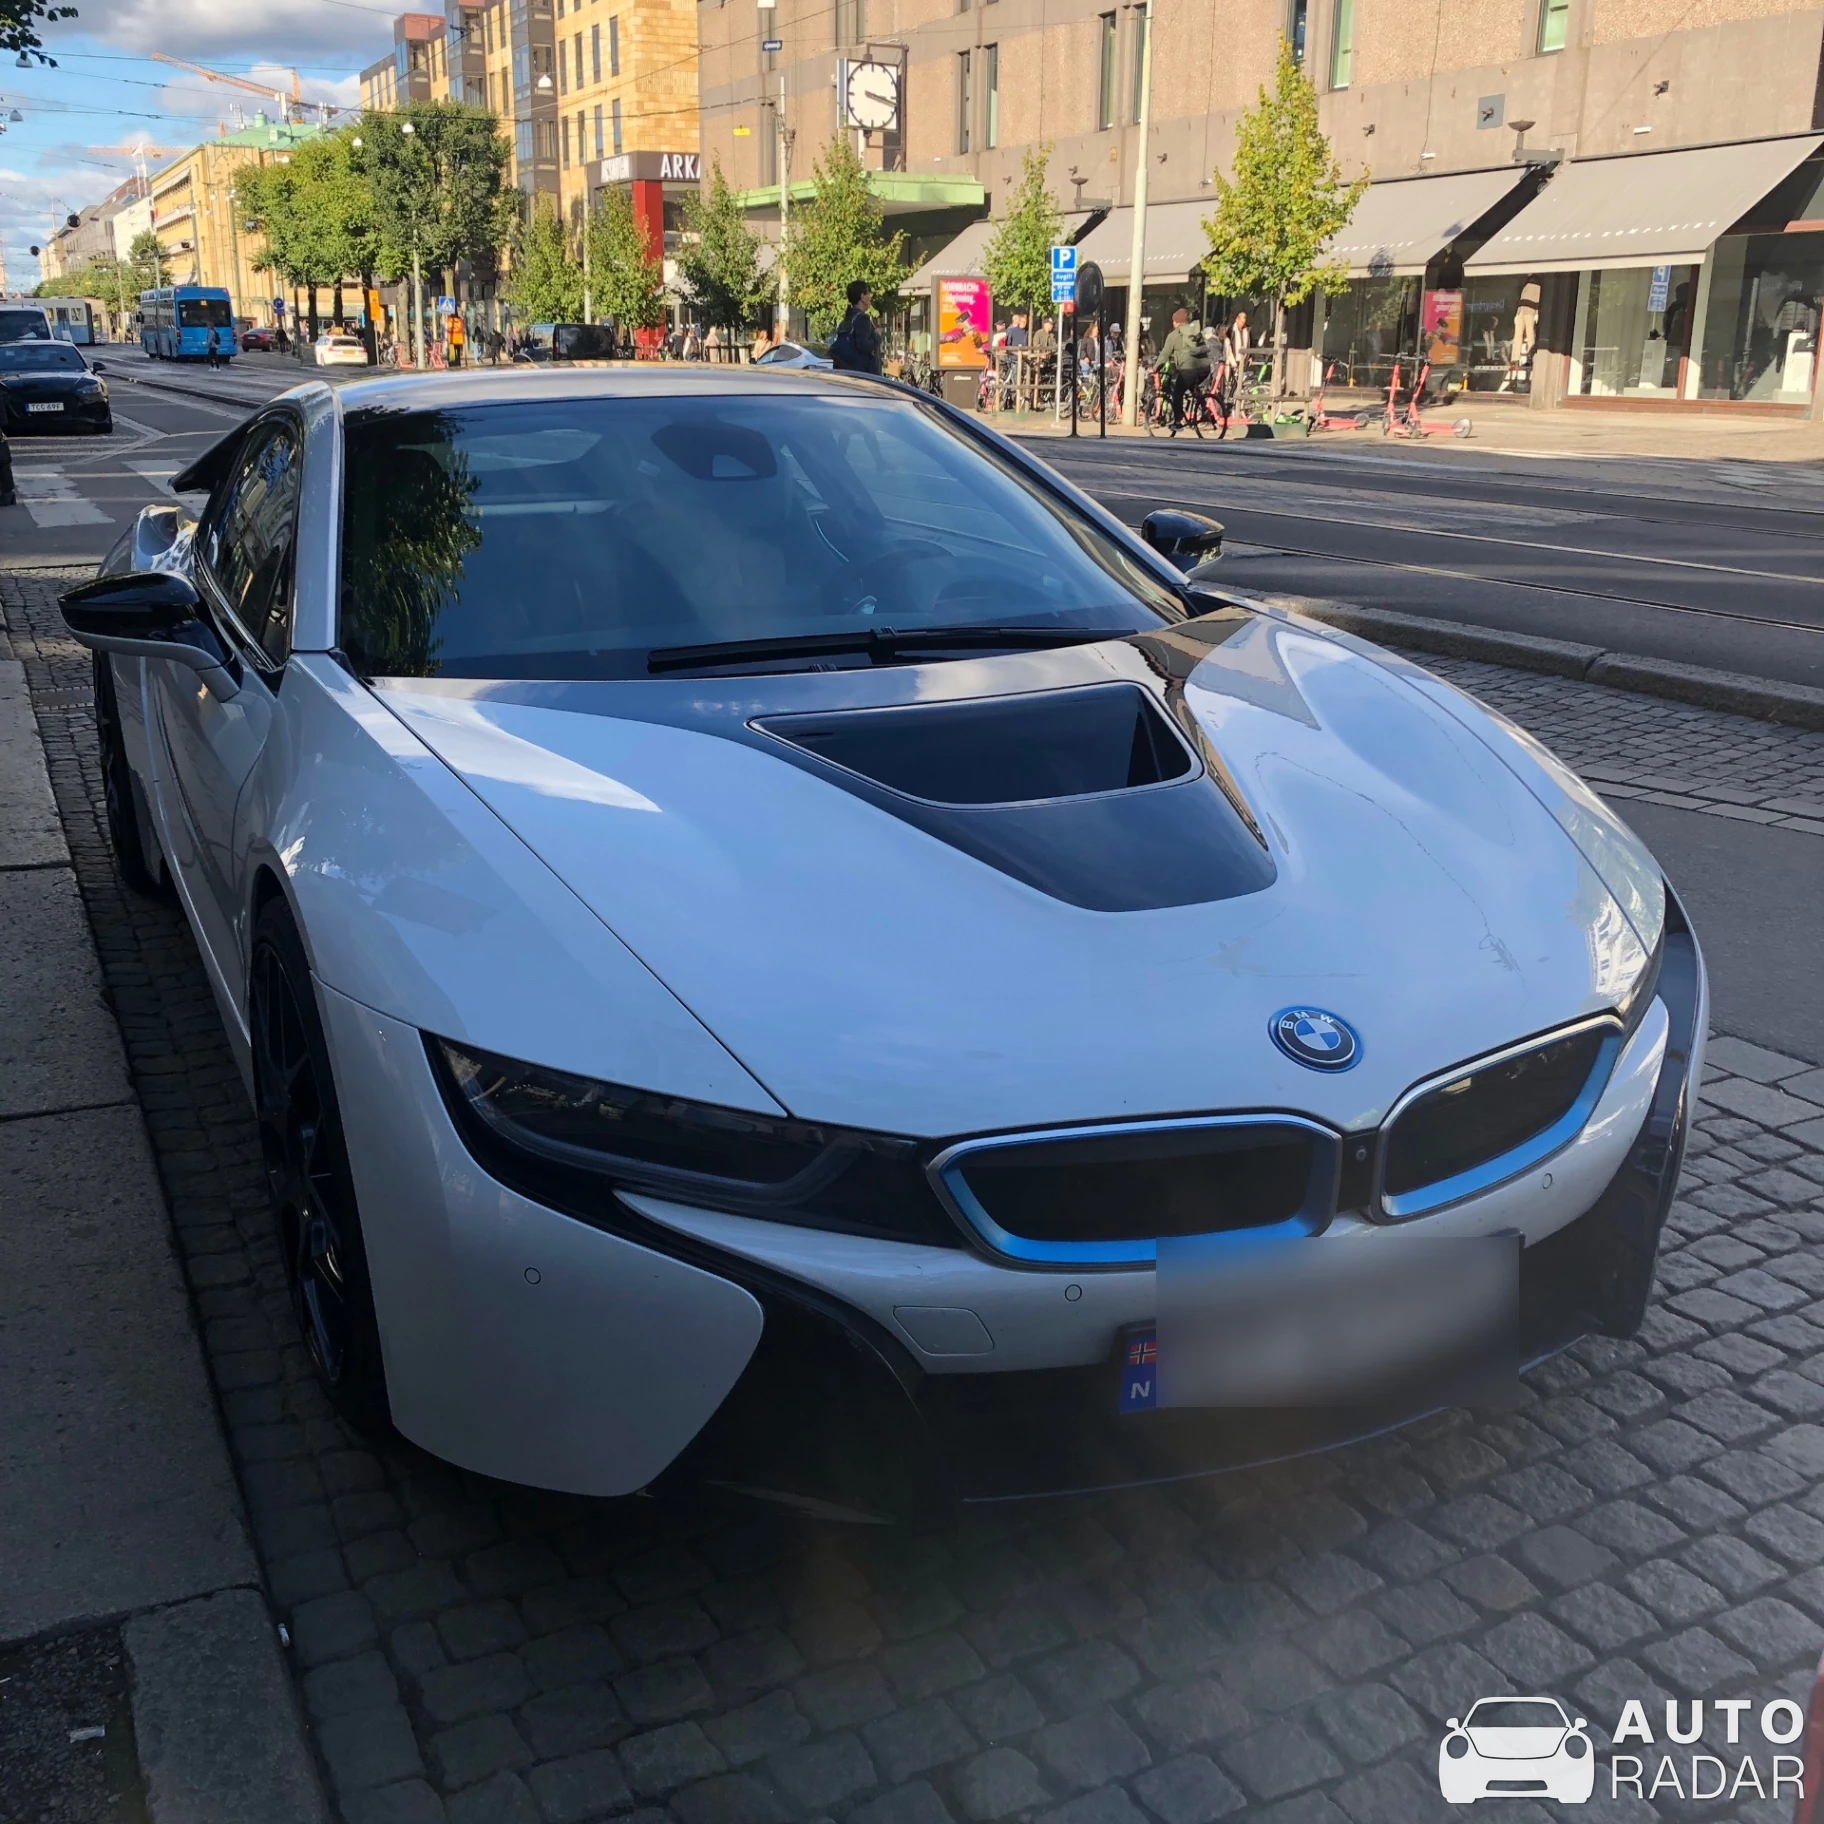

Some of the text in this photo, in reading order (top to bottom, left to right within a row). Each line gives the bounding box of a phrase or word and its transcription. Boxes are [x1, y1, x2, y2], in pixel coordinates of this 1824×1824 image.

[1060, 249, 1071, 268] P
[1281, 1011, 1335, 1030] BMW
[1130, 1381, 1151, 1399] N
